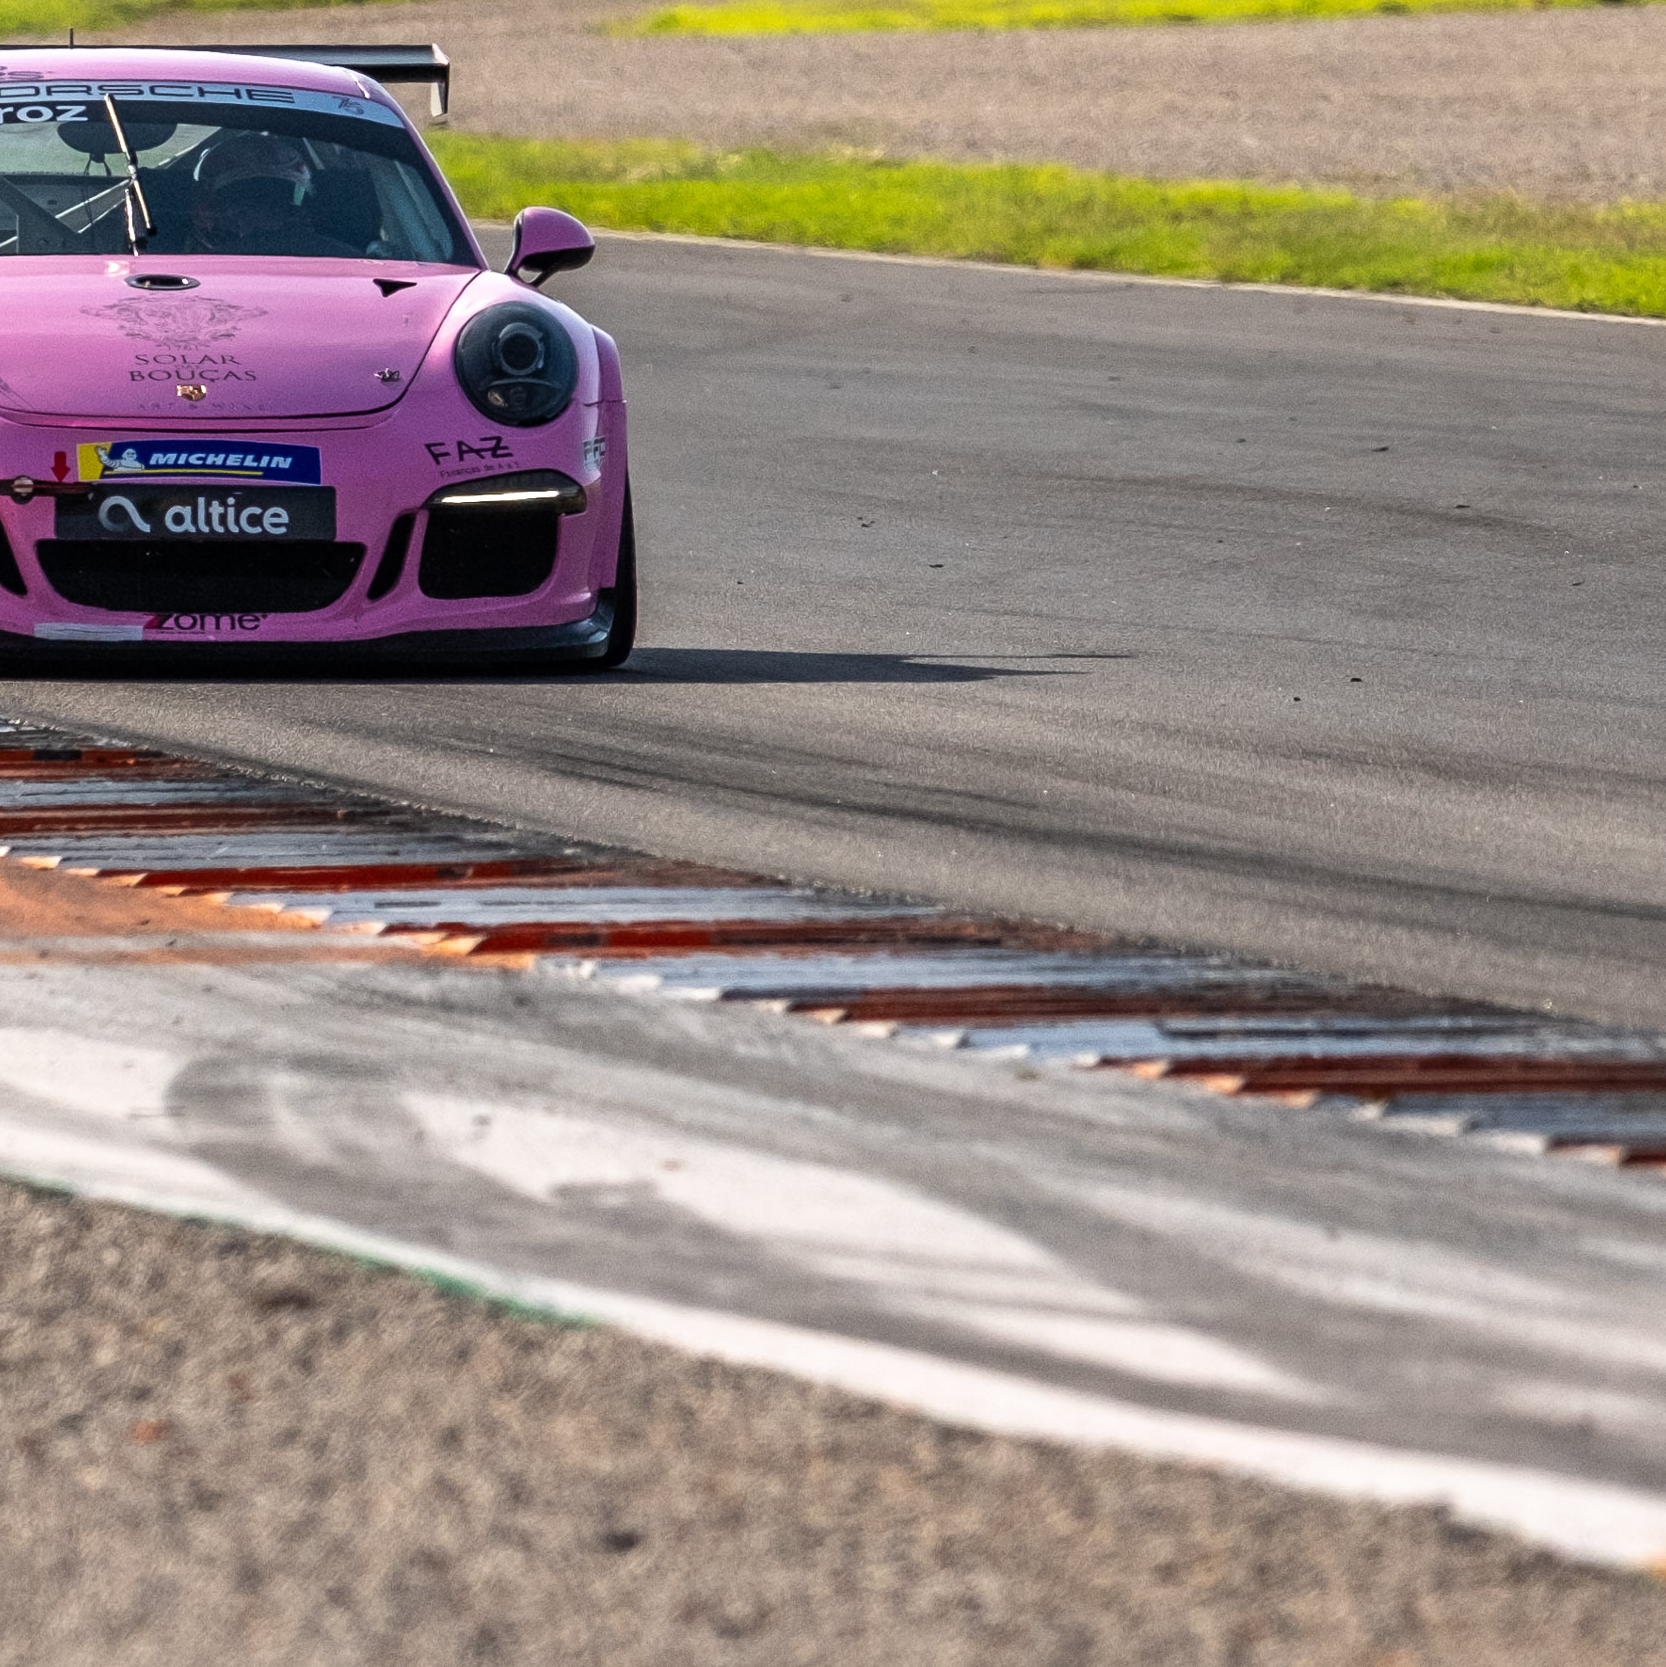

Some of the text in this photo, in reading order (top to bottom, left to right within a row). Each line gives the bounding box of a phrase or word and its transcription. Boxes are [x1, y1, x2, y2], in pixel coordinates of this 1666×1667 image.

[134, 354, 243, 366] SOLAR
[129, 370, 258, 383] BOUÇAS
[424, 436, 514, 465] FAZ
[149, 453, 293, 469] MICHELIN
[164, 497, 290, 534] altice
